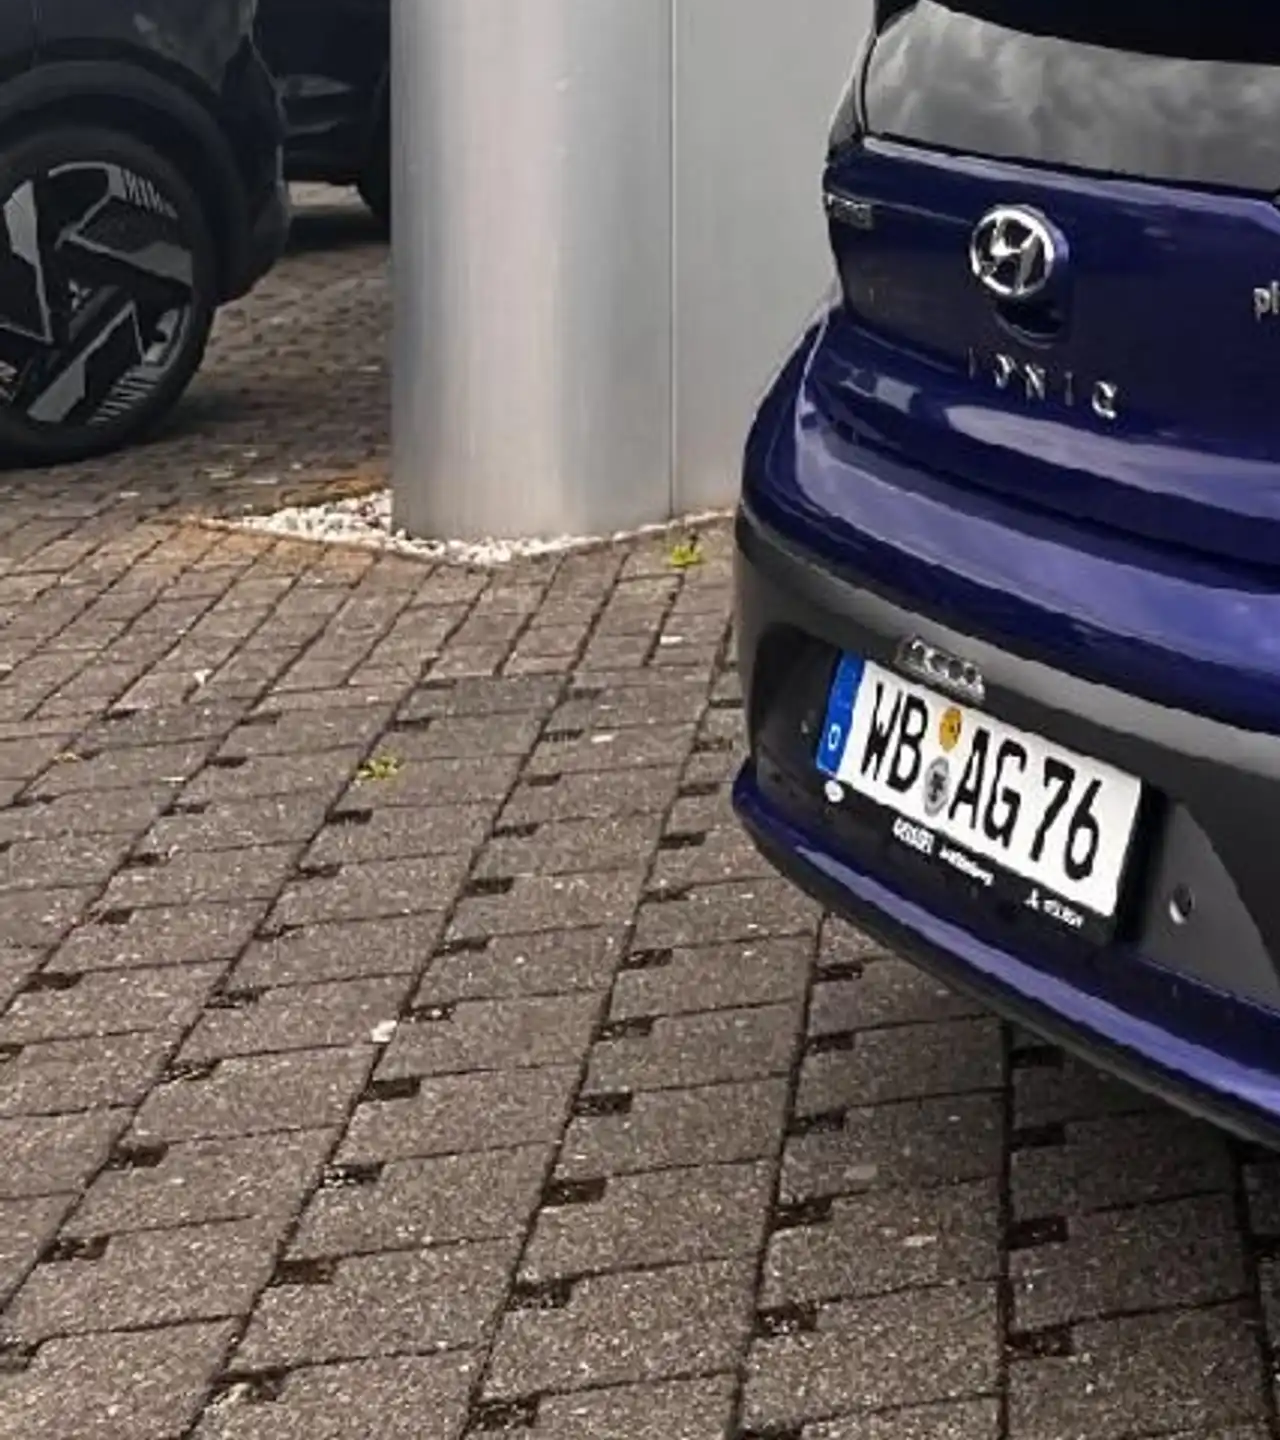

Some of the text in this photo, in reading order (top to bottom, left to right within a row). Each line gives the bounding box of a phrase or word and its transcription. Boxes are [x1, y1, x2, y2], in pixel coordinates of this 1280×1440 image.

[860, 683, 929, 794] WB
[948, 726, 1028, 850] AG
[1028, 756, 1103, 882] 76
